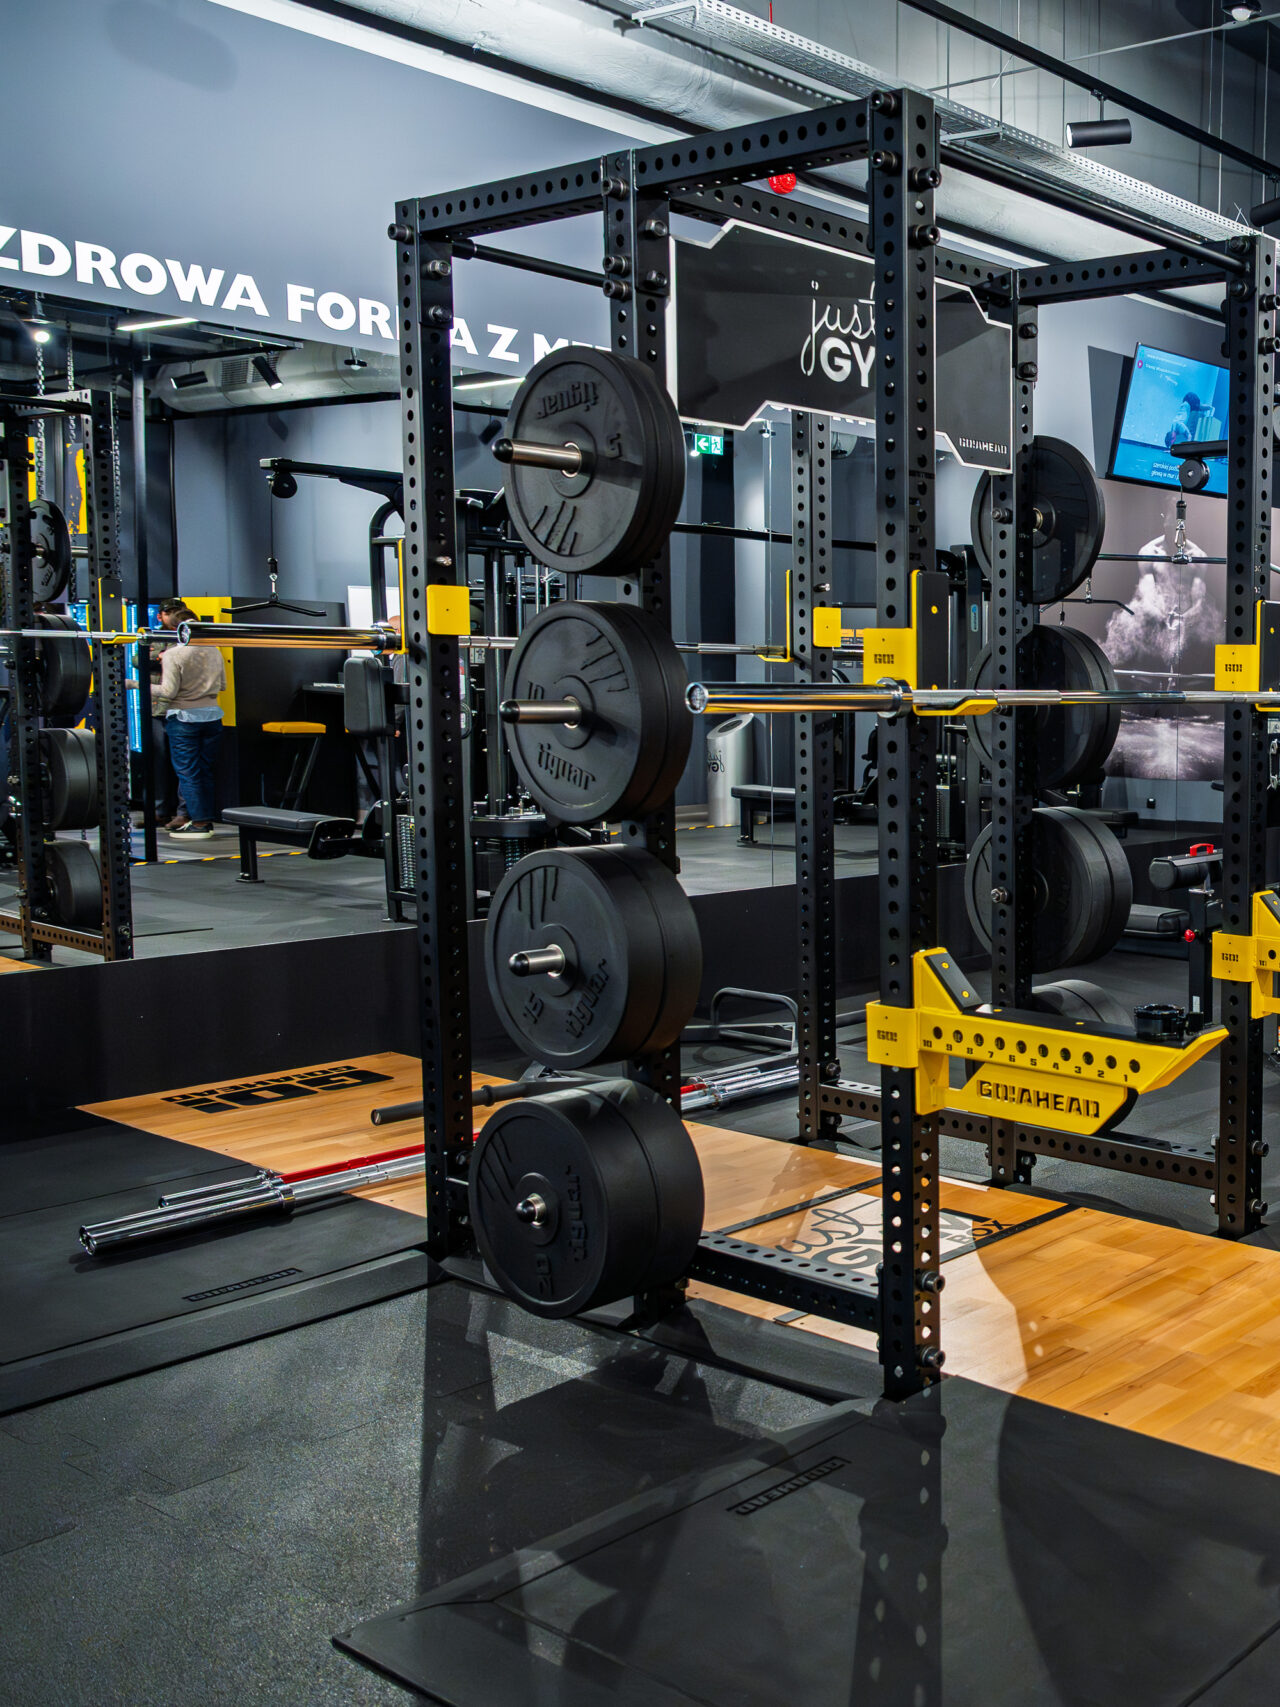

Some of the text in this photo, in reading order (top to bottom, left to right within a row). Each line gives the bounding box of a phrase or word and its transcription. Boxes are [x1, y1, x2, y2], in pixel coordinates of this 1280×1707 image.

[286, 283, 479, 355] FORA
[487, 323, 520, 363] Z
[537, 743, 596, 791] tiguar
[522, 991, 545, 1025] 15
[565, 958, 612, 1040] tiguar
[922, 1039, 933, 1048] 10
[946, 1043, 953, 1051] 9
[966, 1047, 973, 1055] 8
[1009, 1054, 1016, 1062] 6
[1030, 1058, 1037, 1066] 5
[1074, 1066, 1082, 1074] 3
[1097, 1070, 1105, 1078] 2
[1123, 1074, 1128, 1082] 1
[976, 1080, 1100, 1119] GO!AHEAD
